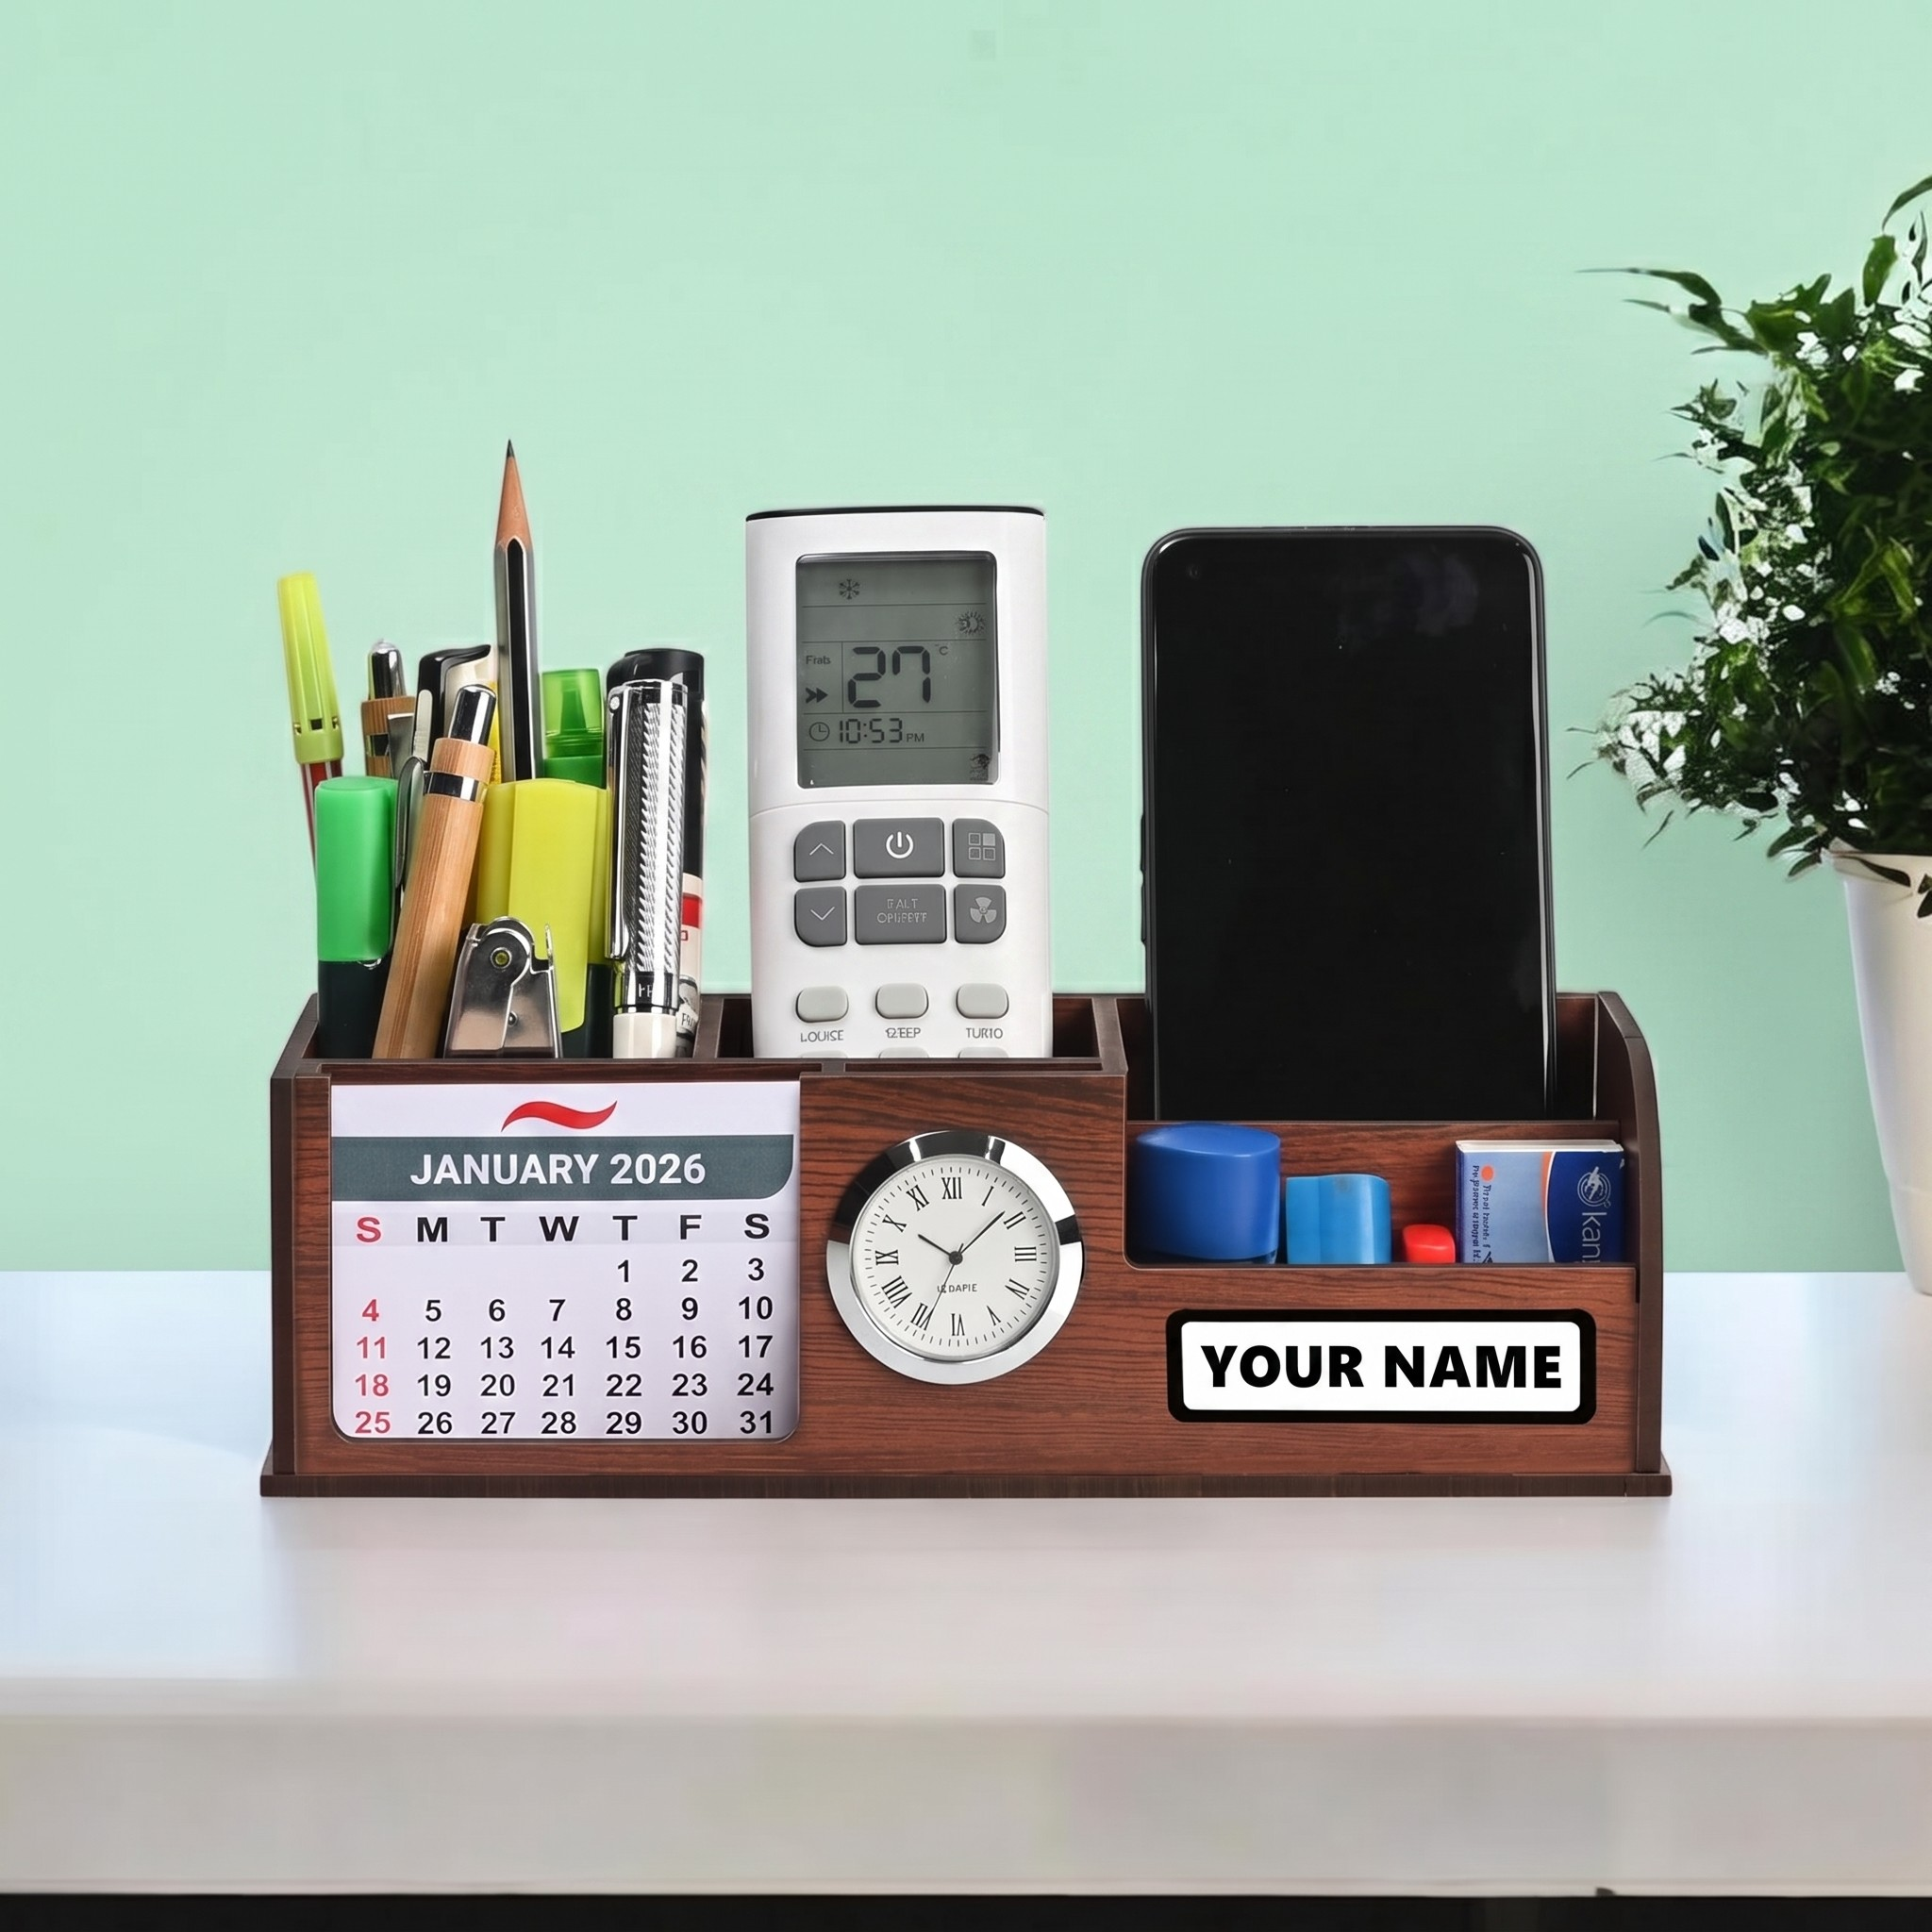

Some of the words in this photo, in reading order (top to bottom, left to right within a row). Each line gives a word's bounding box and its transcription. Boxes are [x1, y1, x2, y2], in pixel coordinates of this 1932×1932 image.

[848, 646, 931, 708] 27
[840, 718, 902, 743] 10:53
[907, 733, 924, 742] PM
[410, 1155, 599, 1184] JANUARY
[610, 1154, 705, 1184] 2026
[906, 1185, 929, 1211] XI
[941, 1177, 962, 1199] XII
[982, 1186, 993, 1206] I
[357, 1217, 381, 1242] S
[418, 1217, 447, 1242] M
[480, 1217, 506, 1241] T
[539, 1216, 579, 1241] W
[612, 1215, 638, 1241] T
[680, 1215, 701, 1240] F
[744, 1214, 769, 1239] S
[882, 1214, 907, 1232] X
[1004, 1211, 1026, 1229] II
[1582, 1212, 1607, 1262] kan
[1014, 1247, 1037, 1261] III
[618, 1260, 628, 1282] 1
[682, 1259, 698, 1282] 2
[749, 1258, 764, 1280] 3
[362, 1299, 379, 1322] 4
[425, 1300, 441, 1322] 5
[489, 1299, 505, 1322] 6
[549, 1299, 565, 1321] 7
[616, 1298, 632, 1321] 8
[682, 1297, 698, 1320] 9
[740, 1296, 773, 1319] 10
[358, 1337, 385, 1358] 11
[418, 1337, 450, 1358] 12
[481, 1337, 513, 1358] 13
[541, 1337, 575, 1358] 14
[607, 1336, 641, 1358] 15
[673, 1336, 707, 1358] 16
[739, 1336, 773, 1357] 17
[1201, 1345, 1364, 1388] YOUR
[1385, 1346, 1561, 1388] NAME
[356, 1374, 389, 1396] 18
[418, 1374, 451, 1396] 19
[481, 1374, 515, 1396] 20
[543, 1374, 573, 1396] 21
[607, 1374, 641, 1396] 22
[672, 1374, 708, 1396] 23
[738, 1373, 774, 1395] 24
[356, 1411, 390, 1433] 25
[418, 1412, 452, 1434] 26
[481, 1412, 515, 1434] 27
[541, 1411, 576, 1434] 28
[606, 1411, 641, 1434] 29
[673, 1411, 707, 1434] 30
[741, 1410, 771, 1434] 31
